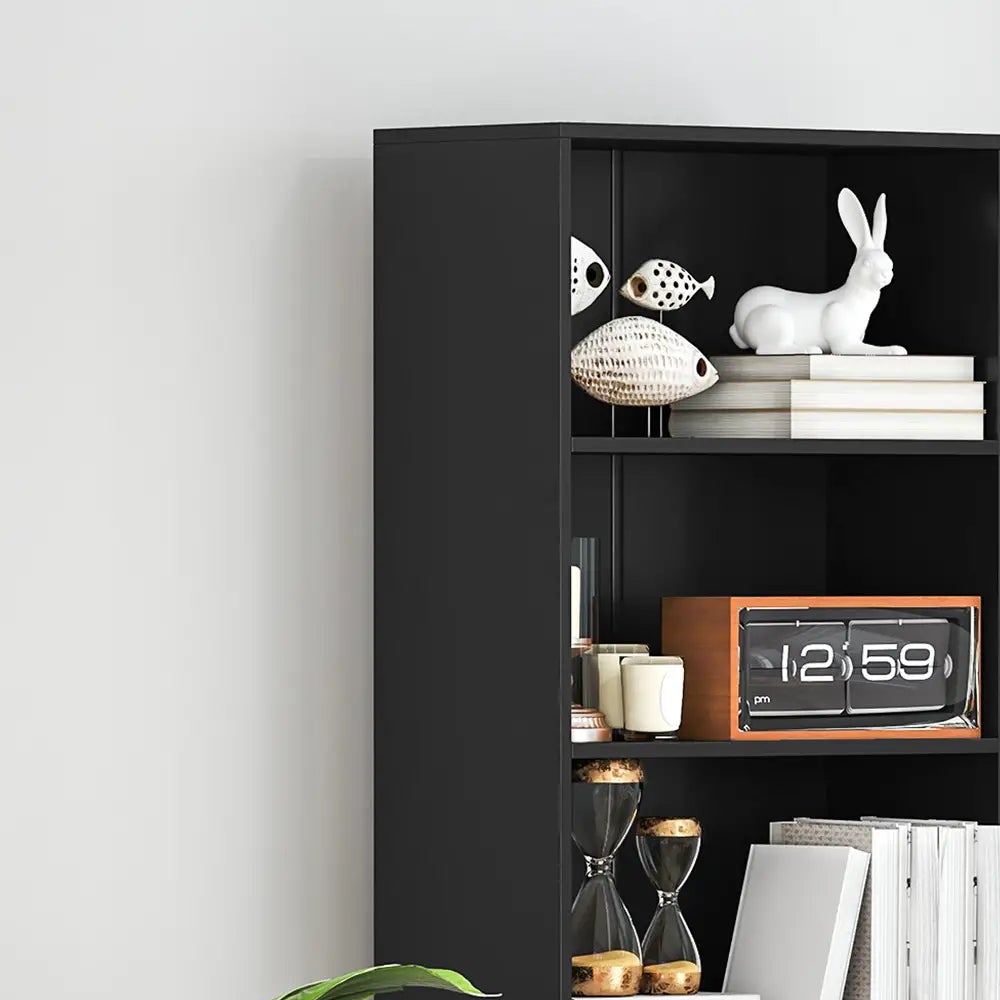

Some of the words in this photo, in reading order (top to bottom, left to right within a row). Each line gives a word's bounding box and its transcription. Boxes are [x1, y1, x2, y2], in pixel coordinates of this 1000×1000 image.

[782, 644, 833, 681] 12
[862, 643, 935, 681] 59
[754, 695, 770, 705] pm
